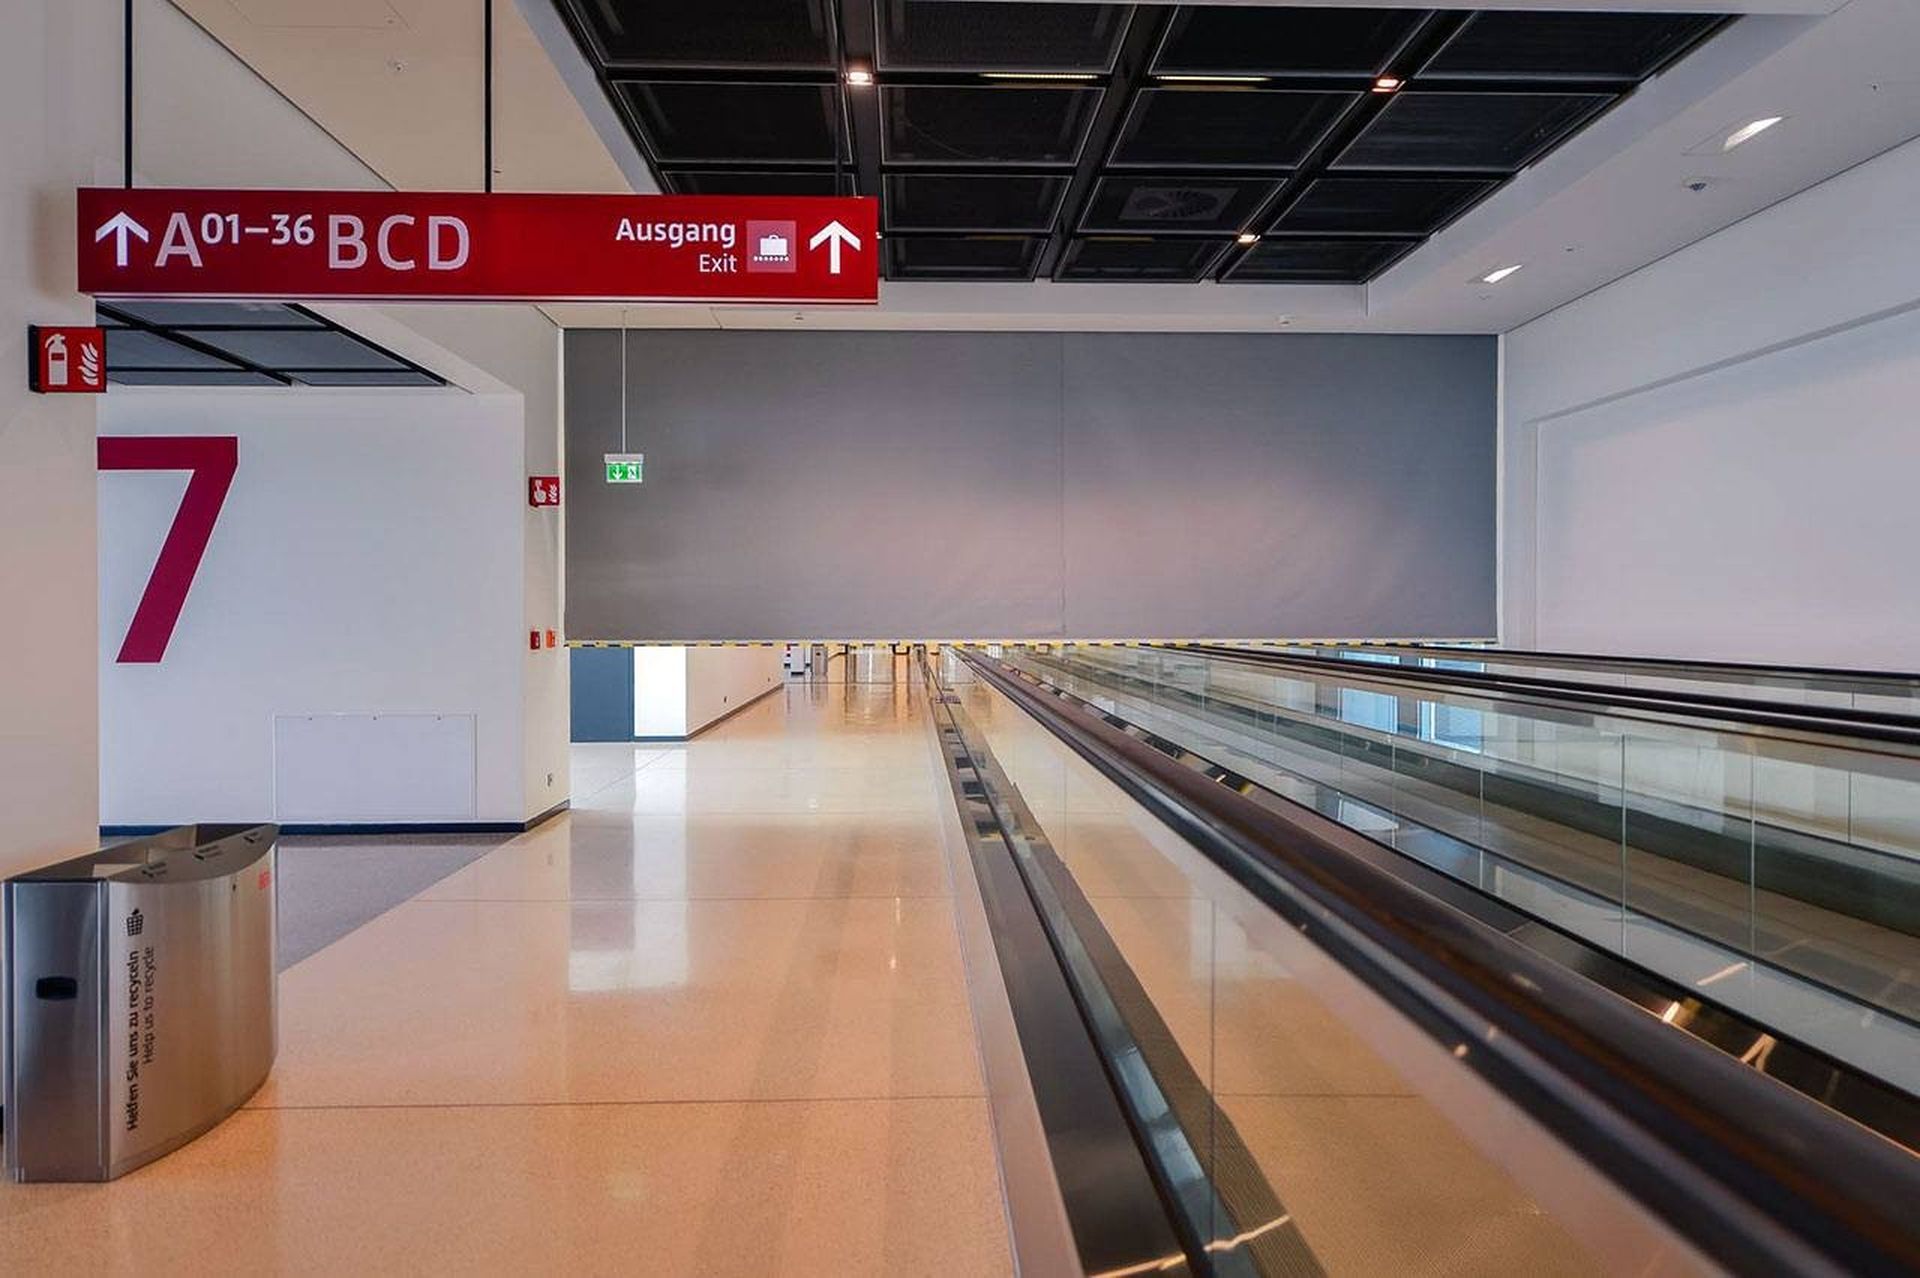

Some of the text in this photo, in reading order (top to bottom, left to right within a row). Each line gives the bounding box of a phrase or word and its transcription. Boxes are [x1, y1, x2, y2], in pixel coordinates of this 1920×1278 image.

[615, 217, 737, 249] Ausgang
[699, 252, 738, 273] Exit
[96, 435, 239, 664] 7
[126, 950, 142, 1132] Helfen Sie uns zu recyceln
[142, 946, 156, 1065] Help us to recycle
